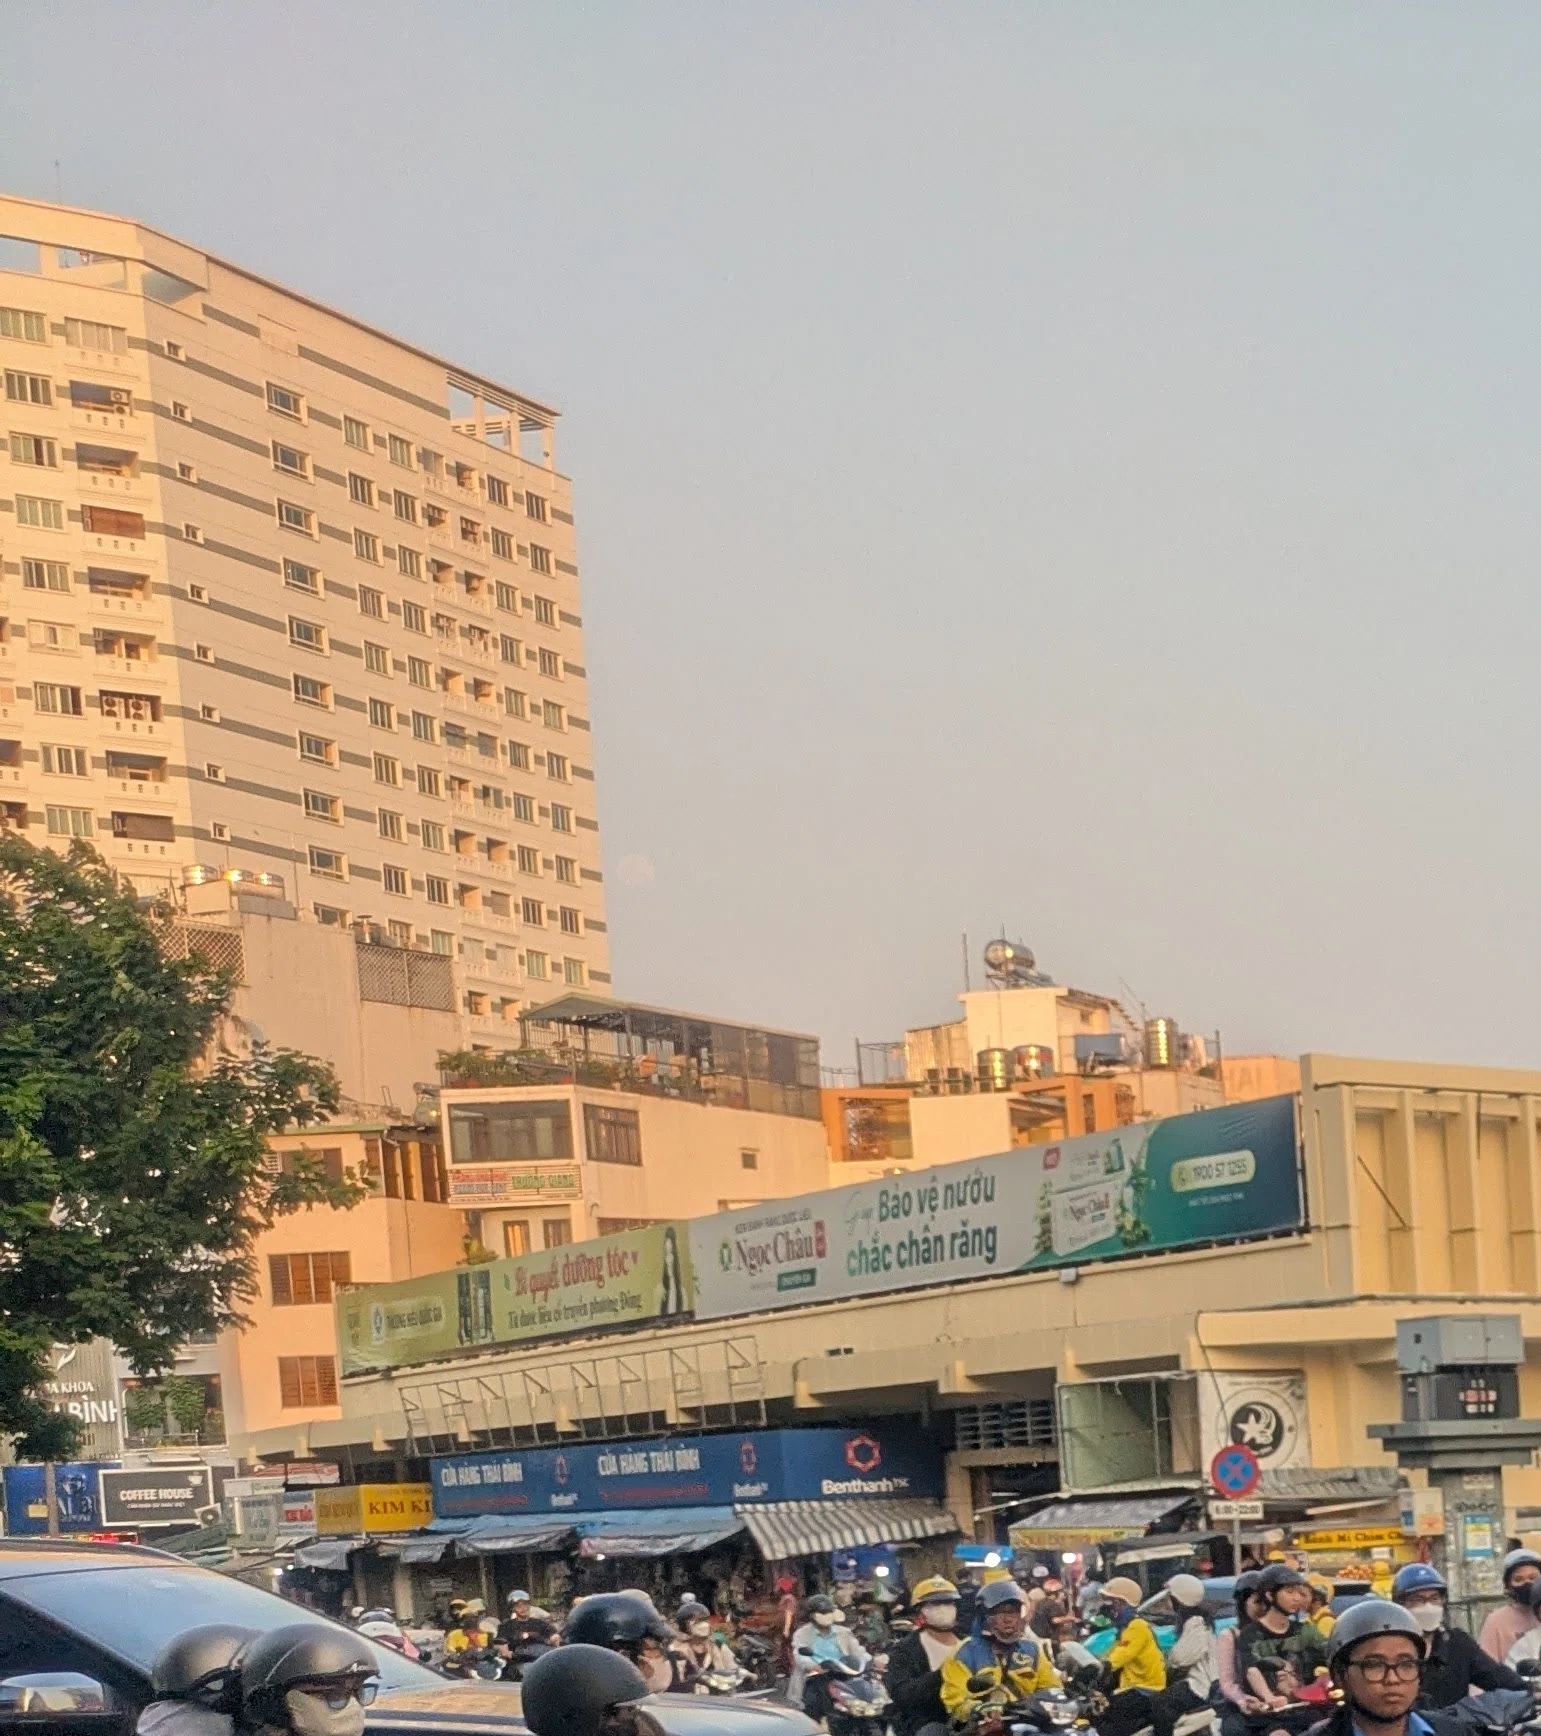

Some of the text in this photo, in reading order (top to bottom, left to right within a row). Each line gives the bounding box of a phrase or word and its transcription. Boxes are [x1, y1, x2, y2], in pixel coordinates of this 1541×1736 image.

[879, 1183, 912, 1222] Bảo
[918, 1176, 939, 1221] vệ
[943, 1167, 996, 1210] nướu
[847, 1230, 892, 1276] chắc
[950, 1219, 998, 1264] răng
[61, 1381, 94, 1394] KHOA
[120, 1487, 194, 1502] COFFEE HOUSE
[368, 1500, 405, 1516] KIM
